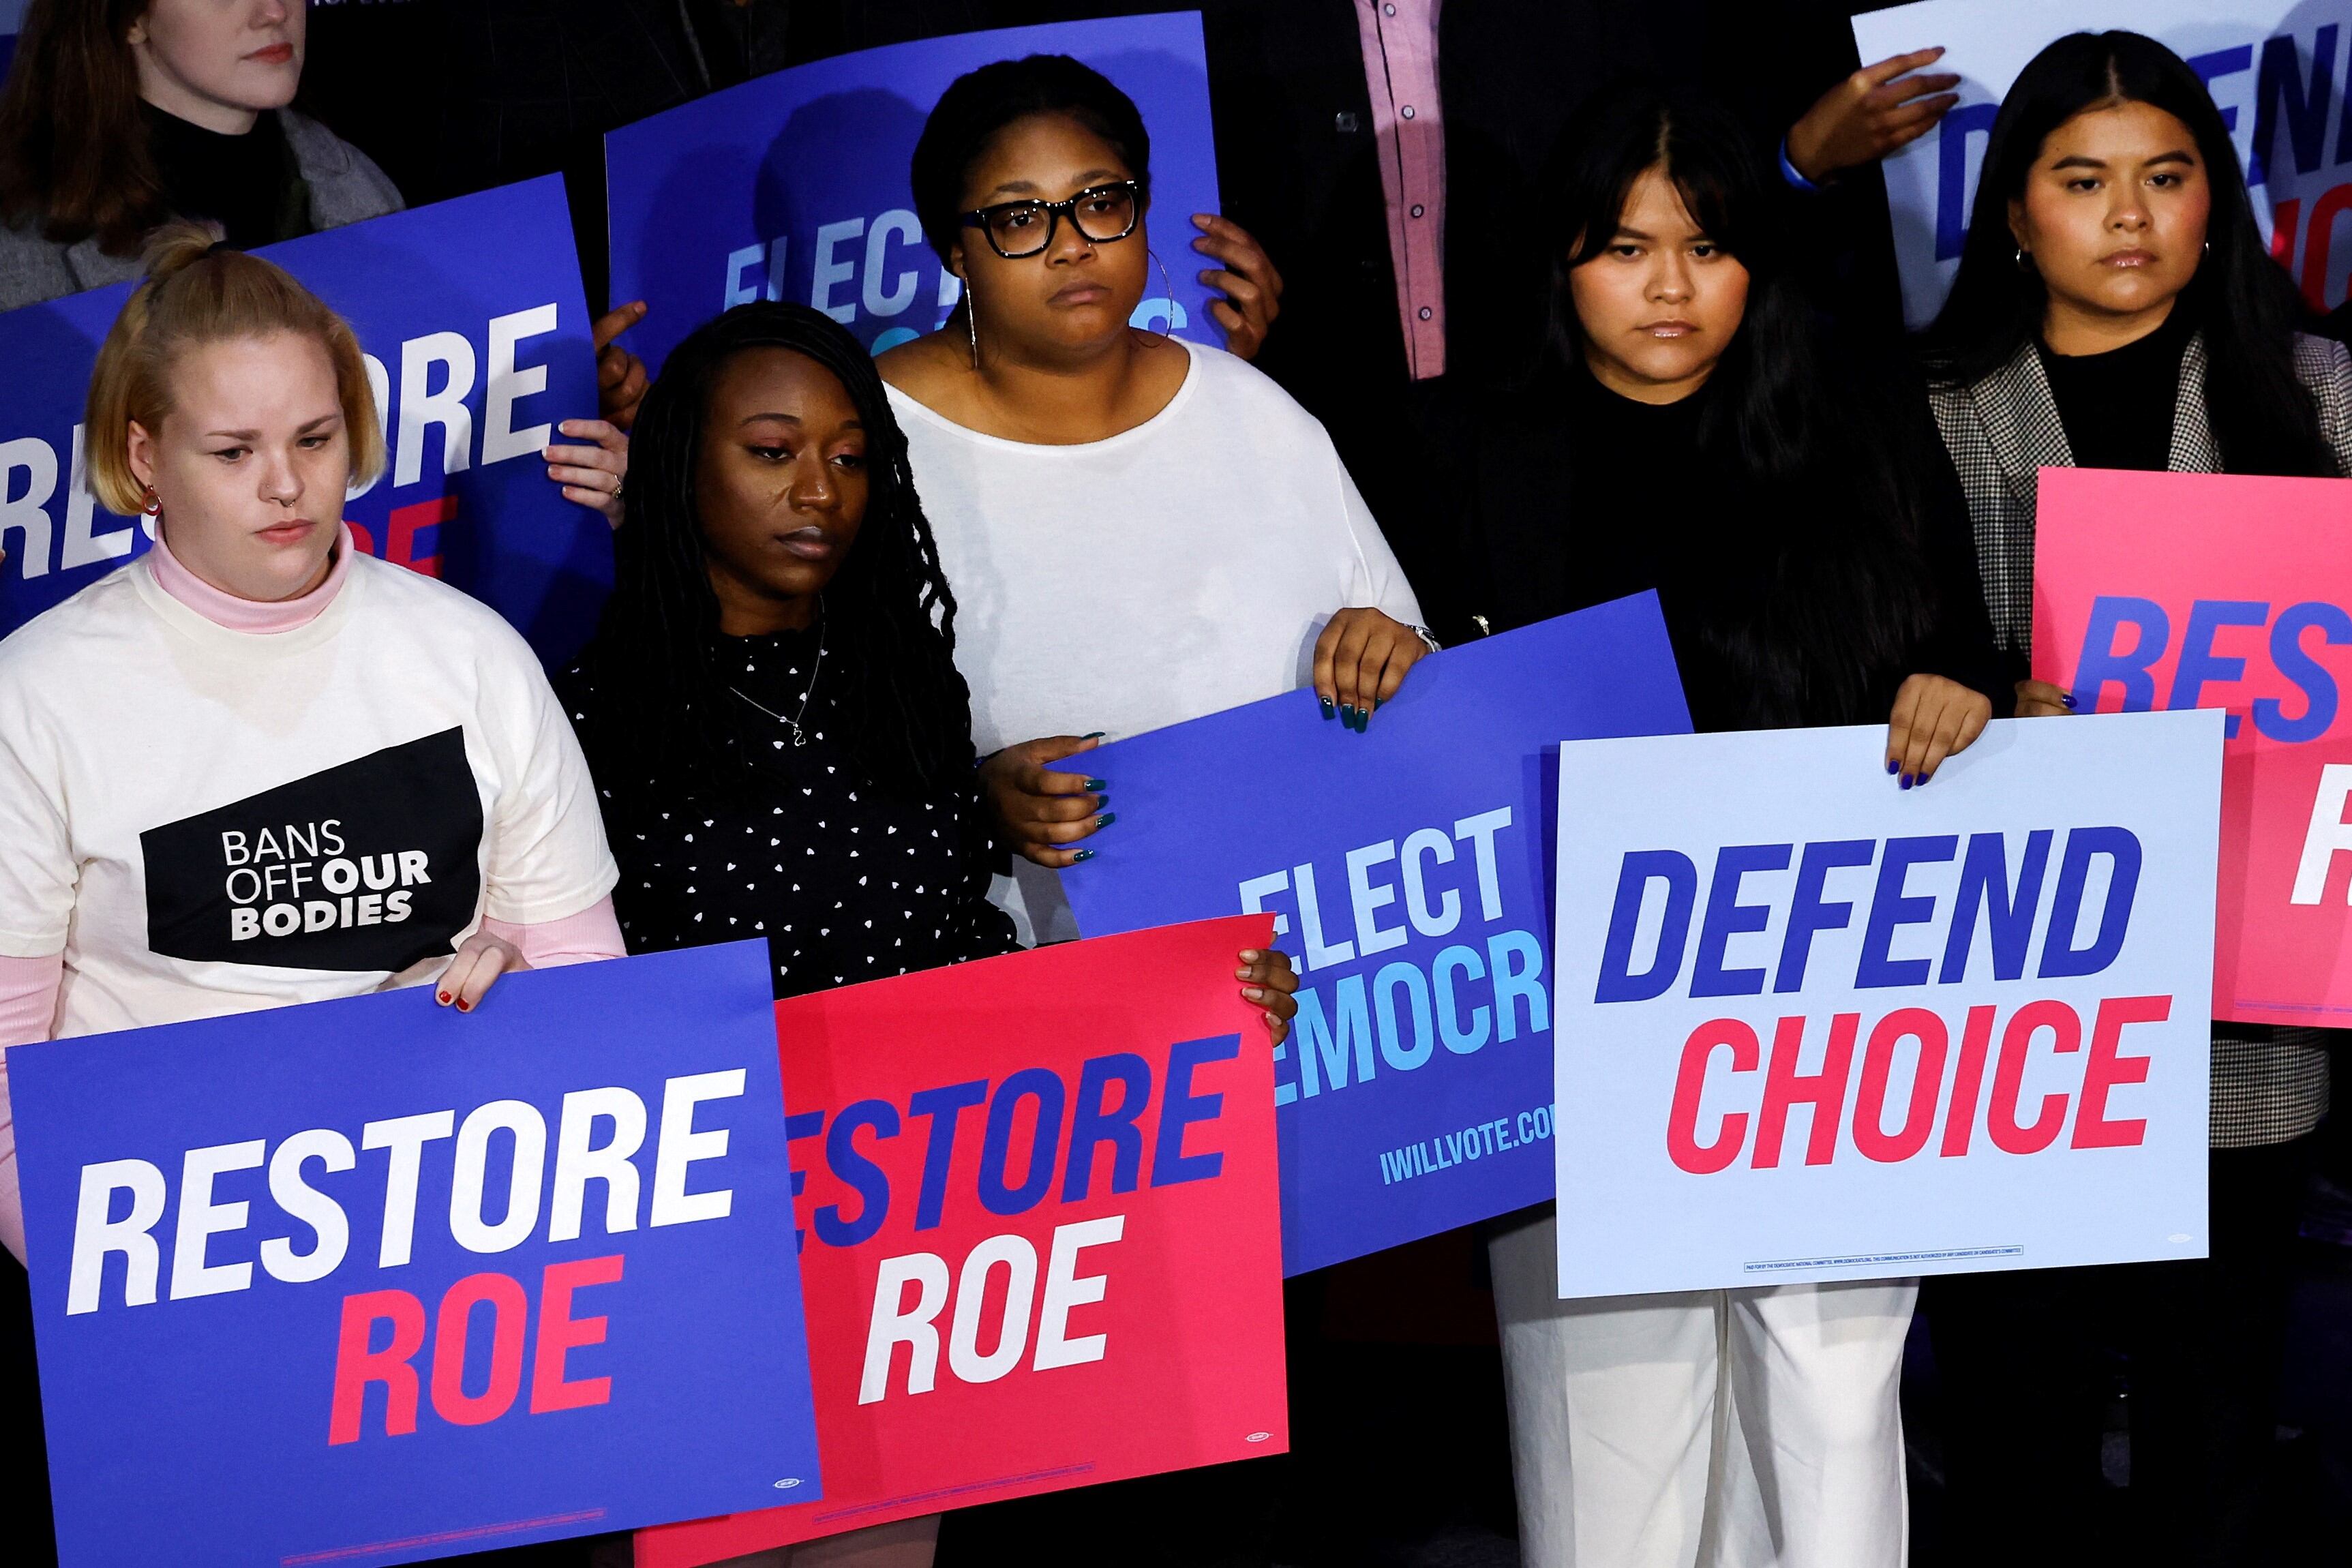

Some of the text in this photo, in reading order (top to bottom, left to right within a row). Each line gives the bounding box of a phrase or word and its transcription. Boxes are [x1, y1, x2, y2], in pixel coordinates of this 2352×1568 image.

[222, 819, 346, 866] BANS
[226, 850, 432, 904] OFF OUR
[231, 890, 413, 941] BODIES
[1594, 826, 2143, 1004] DEFEND
[1666, 995, 2173, 1174] CHOICE
[66, 1068, 747, 1316] RESTORE
[328, 1254, 624, 1445] ROE
[858, 1214, 1125, 1405] ROE
